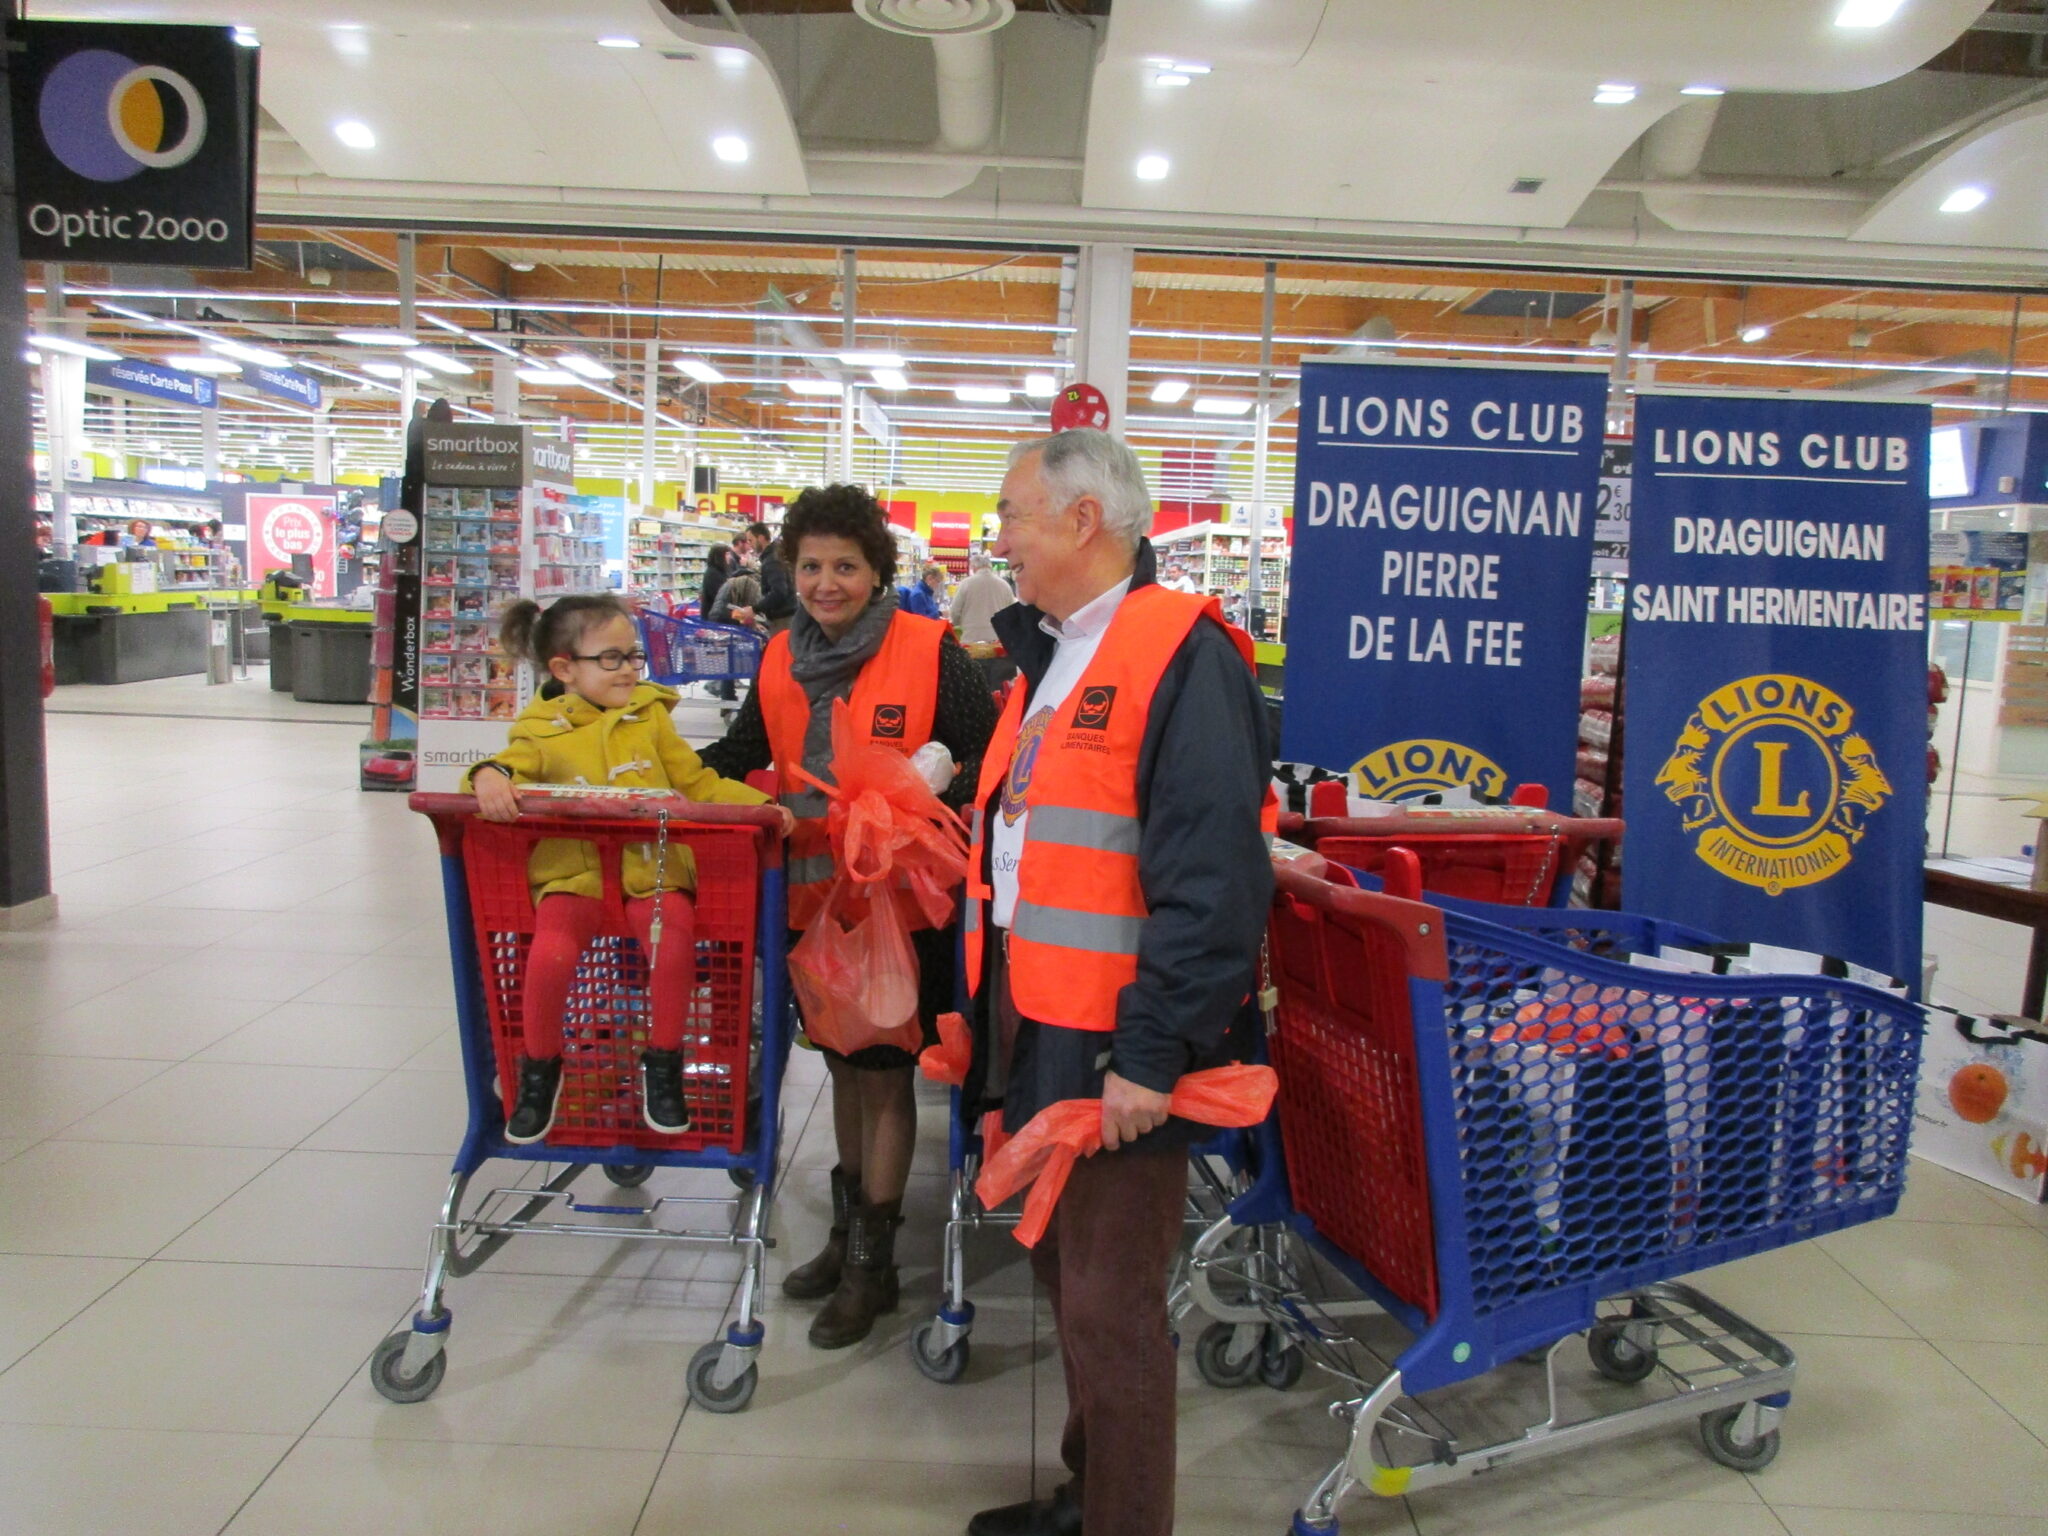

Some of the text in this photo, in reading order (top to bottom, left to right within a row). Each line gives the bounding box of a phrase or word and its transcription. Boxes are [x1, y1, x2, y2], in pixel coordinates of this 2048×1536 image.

[29, 204, 228, 247] Optic 2000
[150, 373, 173, 391] Carte
[174, 379, 193, 395] Pass
[1317, 396, 1584, 444] LIONS CLUB
[71, 459, 78, 470] 9
[427, 436, 520, 454] smartbox
[1655, 428, 1910, 472] LIONS CLUB
[1237, 506, 1244, 515] 4
[1269, 508, 1276, 518] 3
[1308, 481, 1582, 538] DRAGUIGNAN
[1596, 484, 1612, 520] 2
[1613, 502, 1631, 521] 30
[275, 527, 311, 539] le plus
[283, 540, 303, 550] bas
[1673, 517, 1886, 561] DRAGUIGNAN
[1382, 551, 1500, 600] PIERRE
[1632, 584, 1924, 632] SAINT HERMENTAIRE
[401, 616, 415, 692] Wonderbox
[1349, 615, 1524, 667] DE LA FEE
[1710, 680, 1844, 729] LIONS
[424, 749, 496, 763] smartb
[1360, 744, 1497, 793] LIONS
[1751, 742, 1811, 818] L
[1708, 836, 1842, 880] INTERNATIONAL
